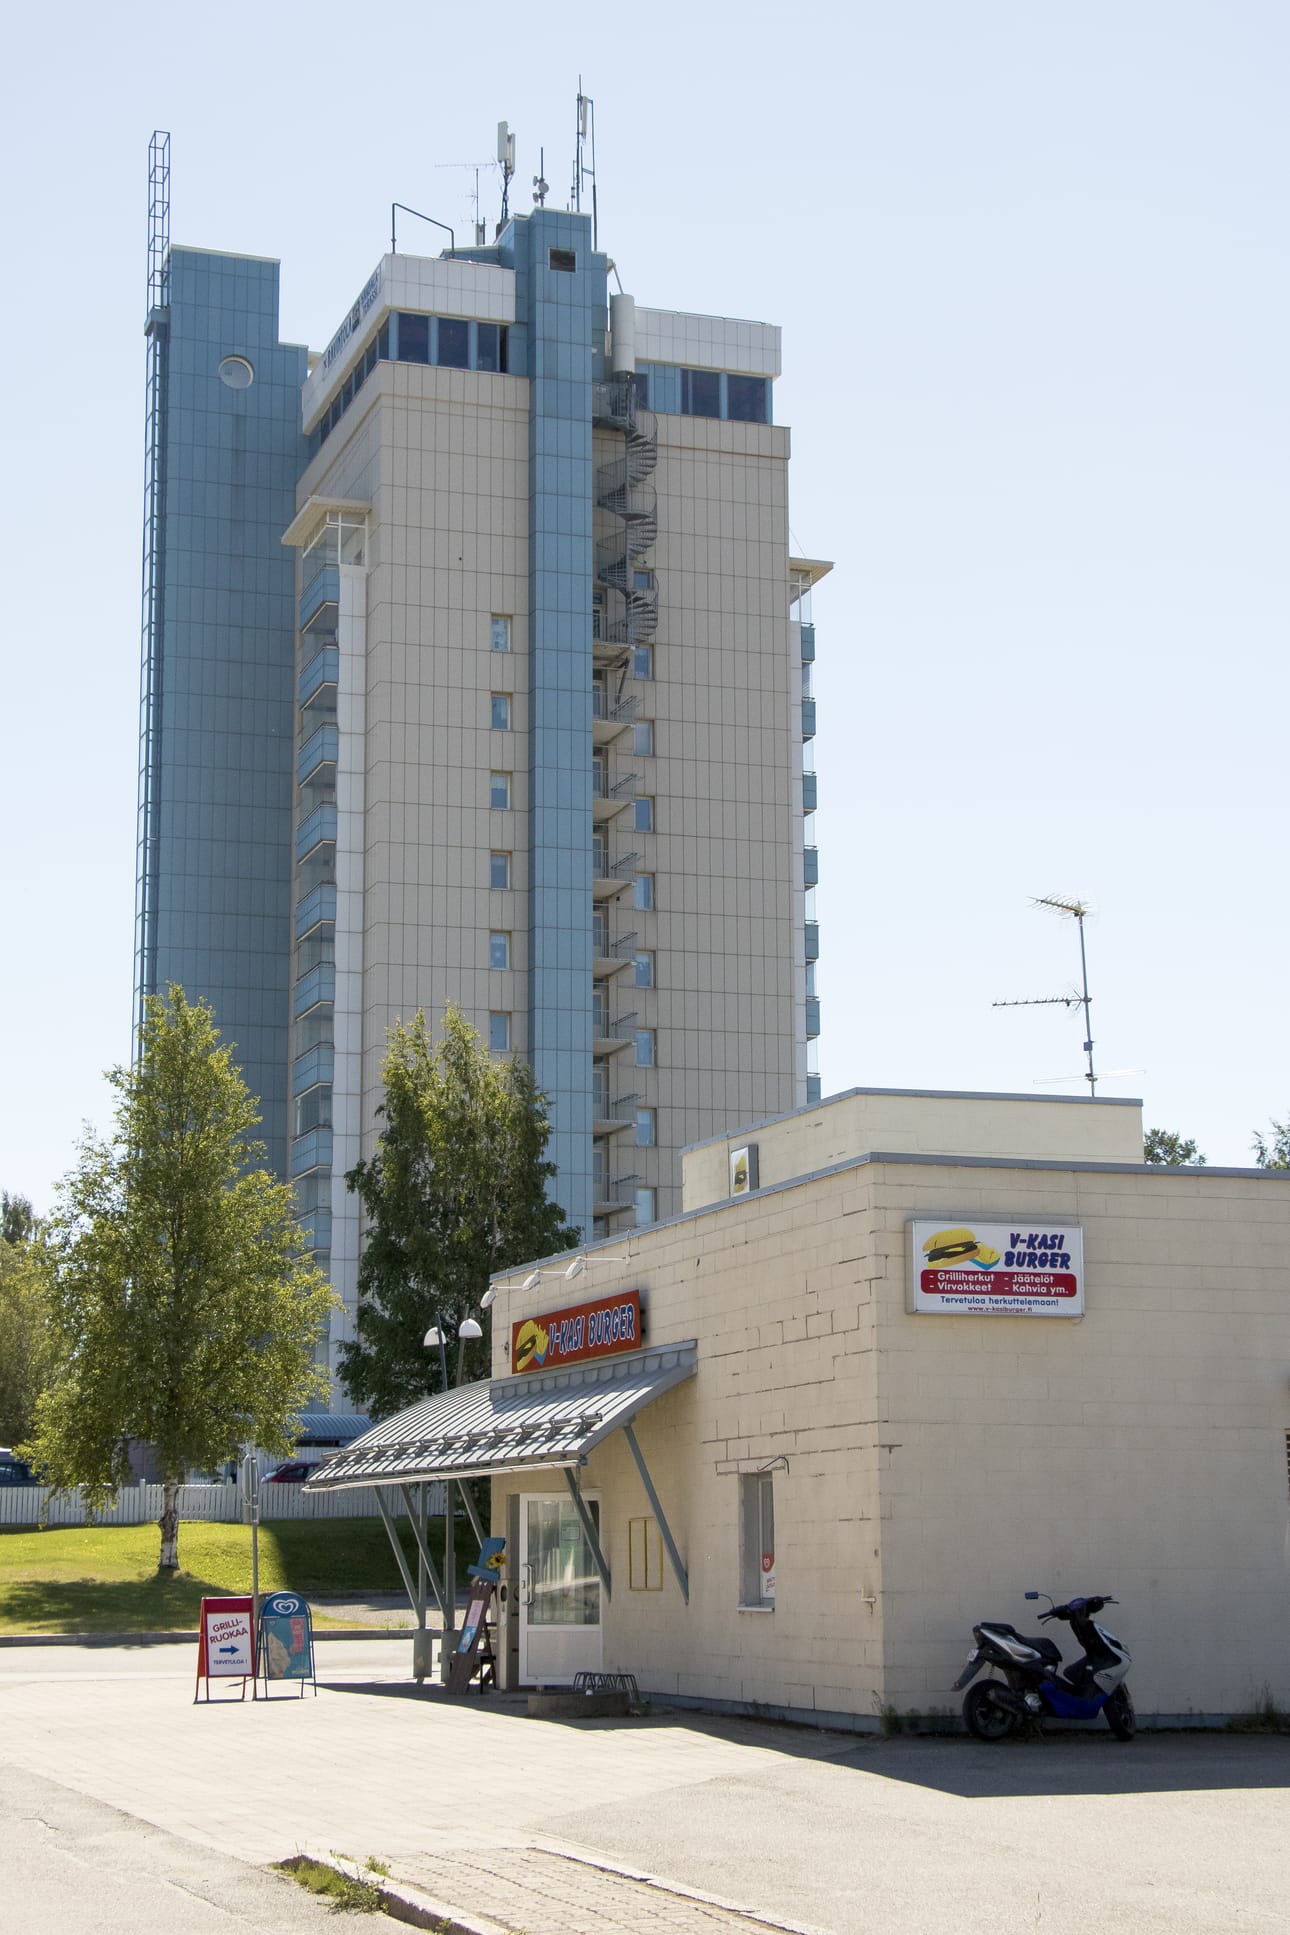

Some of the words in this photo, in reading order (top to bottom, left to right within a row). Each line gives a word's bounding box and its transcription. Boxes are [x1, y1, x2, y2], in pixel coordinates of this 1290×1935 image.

[1009, 1232, 1065, 1250] V-KASI
[1003, 1251, 1070, 1270] BURGER
[937, 1272, 995, 1282] Grilliherkut
[1012, 1274, 1054, 1284] Jäätelöt
[937, 1282, 992, 1292] Virvokkeet
[1012, 1284, 1047, 1293] Kahvia
[1050, 1286, 1069, 1295] ym.
[940, 1296, 986, 1304] Tervetuloa
[988, 1297, 1059, 1307] herkuttelemaan!
[549, 1315, 585, 1355] V-KASI
[588, 1303, 635, 1347] BURGER
[212, 1618, 243, 1632] GRILLI-
[209, 1627, 249, 1644] RUOKAA
